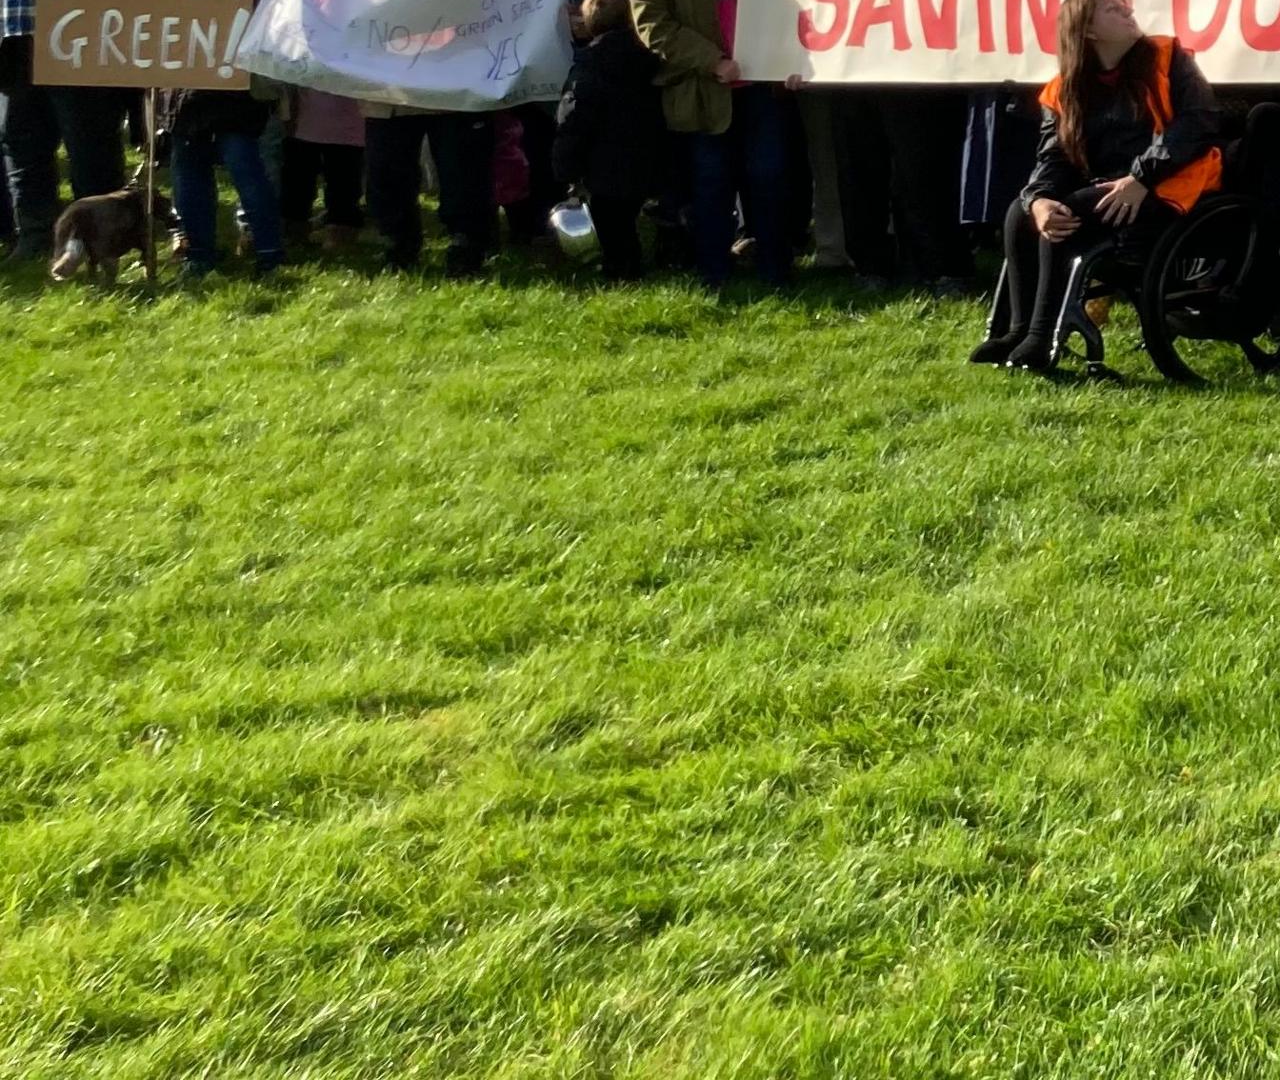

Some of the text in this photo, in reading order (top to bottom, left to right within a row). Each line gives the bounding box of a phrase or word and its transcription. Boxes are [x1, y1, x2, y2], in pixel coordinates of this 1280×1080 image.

[50, 8, 250, 79] GREEN!
[367, 19, 411, 53] NO
[486, 32, 523, 81] YES
